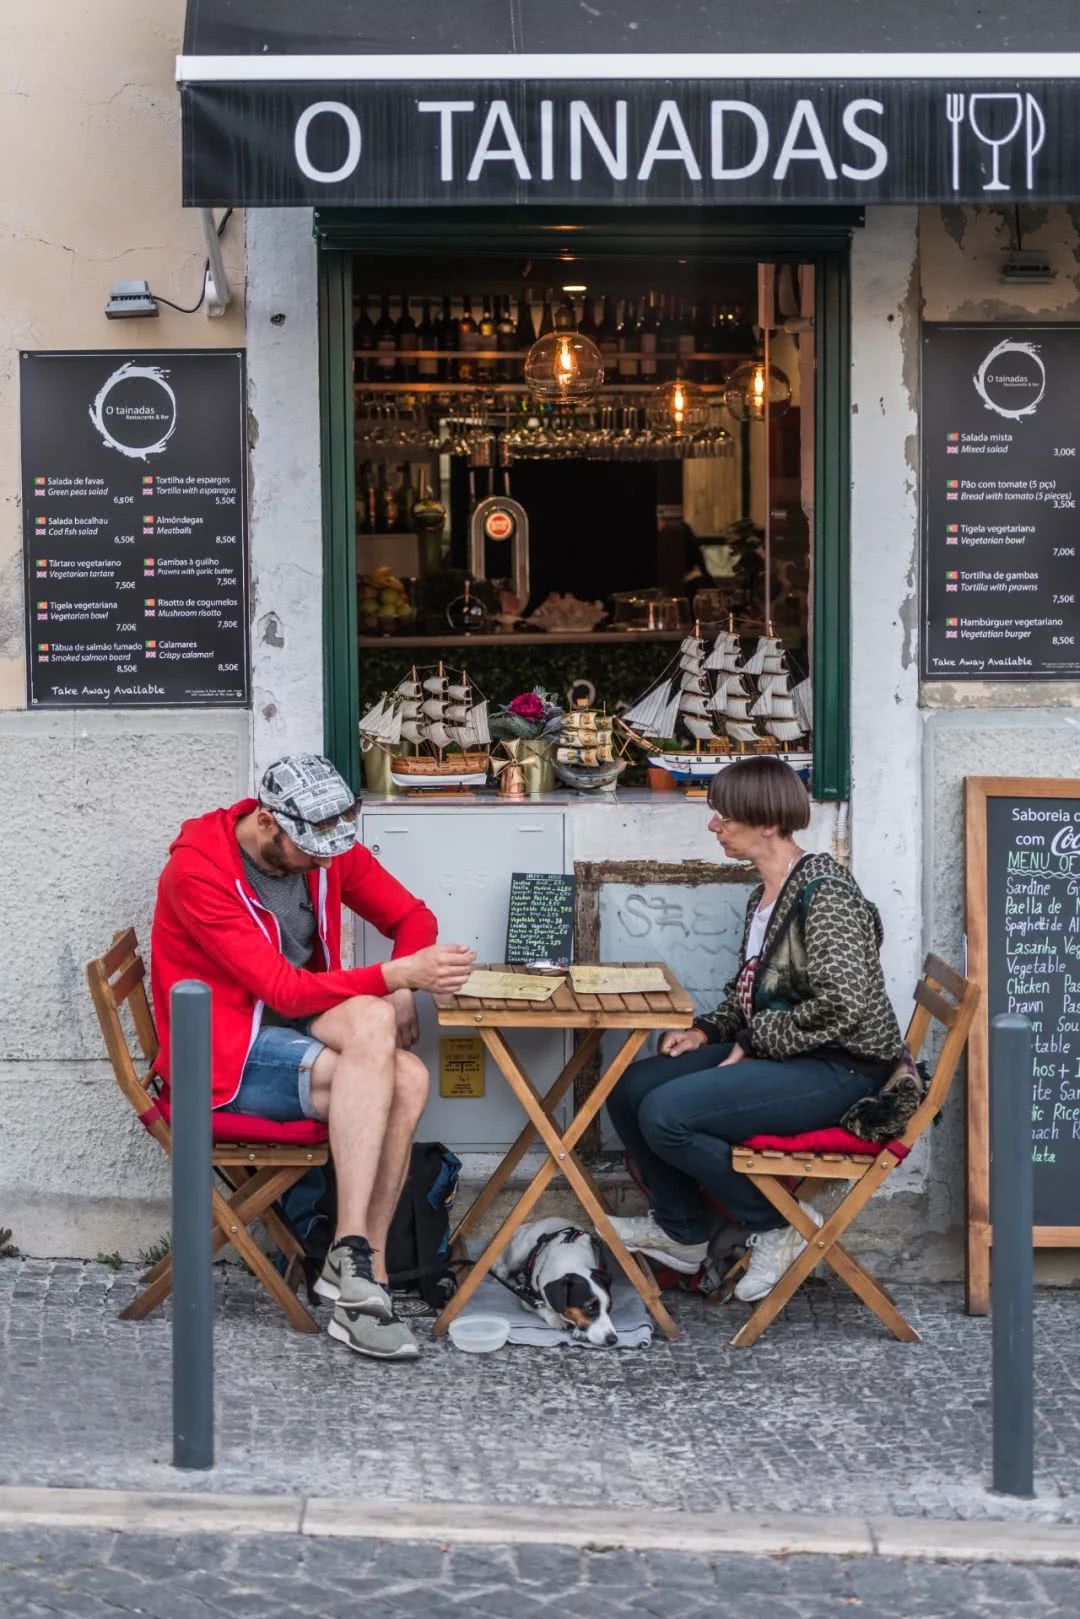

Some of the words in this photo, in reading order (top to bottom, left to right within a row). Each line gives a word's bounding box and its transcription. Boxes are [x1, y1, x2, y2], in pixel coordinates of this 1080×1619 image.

[293, 101, 362, 184] O
[418, 98, 888, 183] TAINADAS
[106, 406, 113, 414] O
[116, 406, 154, 414] tainadas
[961, 433, 988, 441] Salada
[990, 433, 1012, 441] mista
[961, 445, 985, 453] Mixed
[48, 477, 70, 485] Salada
[72, 477, 83, 485] de
[84, 477, 104, 485] favas
[156, 476, 183, 484] Tortilha
[185, 476, 195, 484] de
[197, 477, 230, 485] espargos
[1029, 480, 1037, 489] (5
[48, 488, 69, 496] Green
[89, 488, 108, 496] salad
[200, 487, 236, 495] asparagus
[961, 492, 985, 500] Bread
[986, 492, 1002, 500] with
[1044, 493, 1071, 501] pieces)
[49, 517, 72, 525] Salada
[961, 525, 985, 534] Tigela
[988, 525, 1035, 534] vegetariana
[961, 537, 1003, 546] Vegetarian
[77, 560, 121, 568] vegetariano
[50, 570, 89, 579] Vegetarian
[961, 571, 992, 579] Tortilha
[1006, 571, 1038, 581] gambas
[1009, 584, 1037, 592] prawns
[50, 602, 72, 610] Tigela
[74, 602, 117, 610] vegetariana
[197, 599, 237, 607] cogumelos
[51, 613, 89, 621] Vegetarian
[1015, 618, 1063, 627] vegetariano
[1005, 630, 1031, 639] burger
[75, 643, 85, 651] de
[114, 642, 142, 650] fumado
[109, 653, 130, 661] board
[159, 651, 180, 660] Crispy
[933, 658, 955, 666] Take
[959, 659, 984, 669] Away
[988, 656, 1032, 666] Available
[52, 687, 78, 695] Take
[82, 687, 110, 699] Away
[114, 685, 165, 694] Available
[1012, 808, 1070, 821] Saboreia
[1016, 835, 1045, 845] com
[1008, 851, 1050, 869] MENU
[1006, 877, 1051, 895] Sardine
[1006, 896, 1042, 915] Paella
[1048, 897, 1062, 914] de
[1007, 956, 1065, 979] Vegetable
[1007, 978, 1050, 995] Chicken
[1008, 996, 1043, 1013] Prawn
